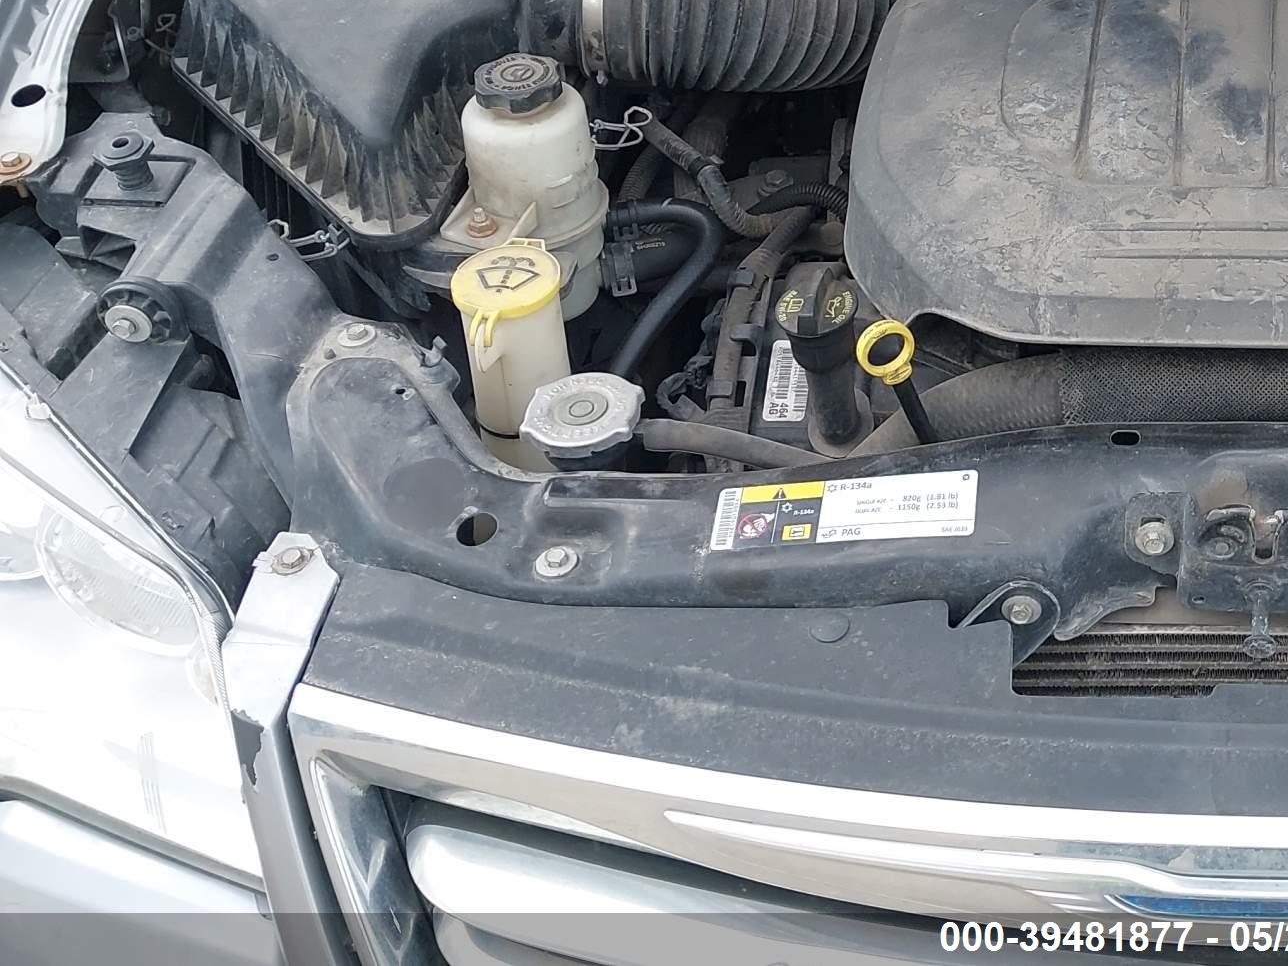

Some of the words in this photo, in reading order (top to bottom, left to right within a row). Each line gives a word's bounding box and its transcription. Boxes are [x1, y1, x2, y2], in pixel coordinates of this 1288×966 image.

[842, 291, 854, 314] ENGINE
[831, 314, 846, 324] OIL
[840, 482, 872, 491] R-134a
[841, 527, 861, 536] PAG
